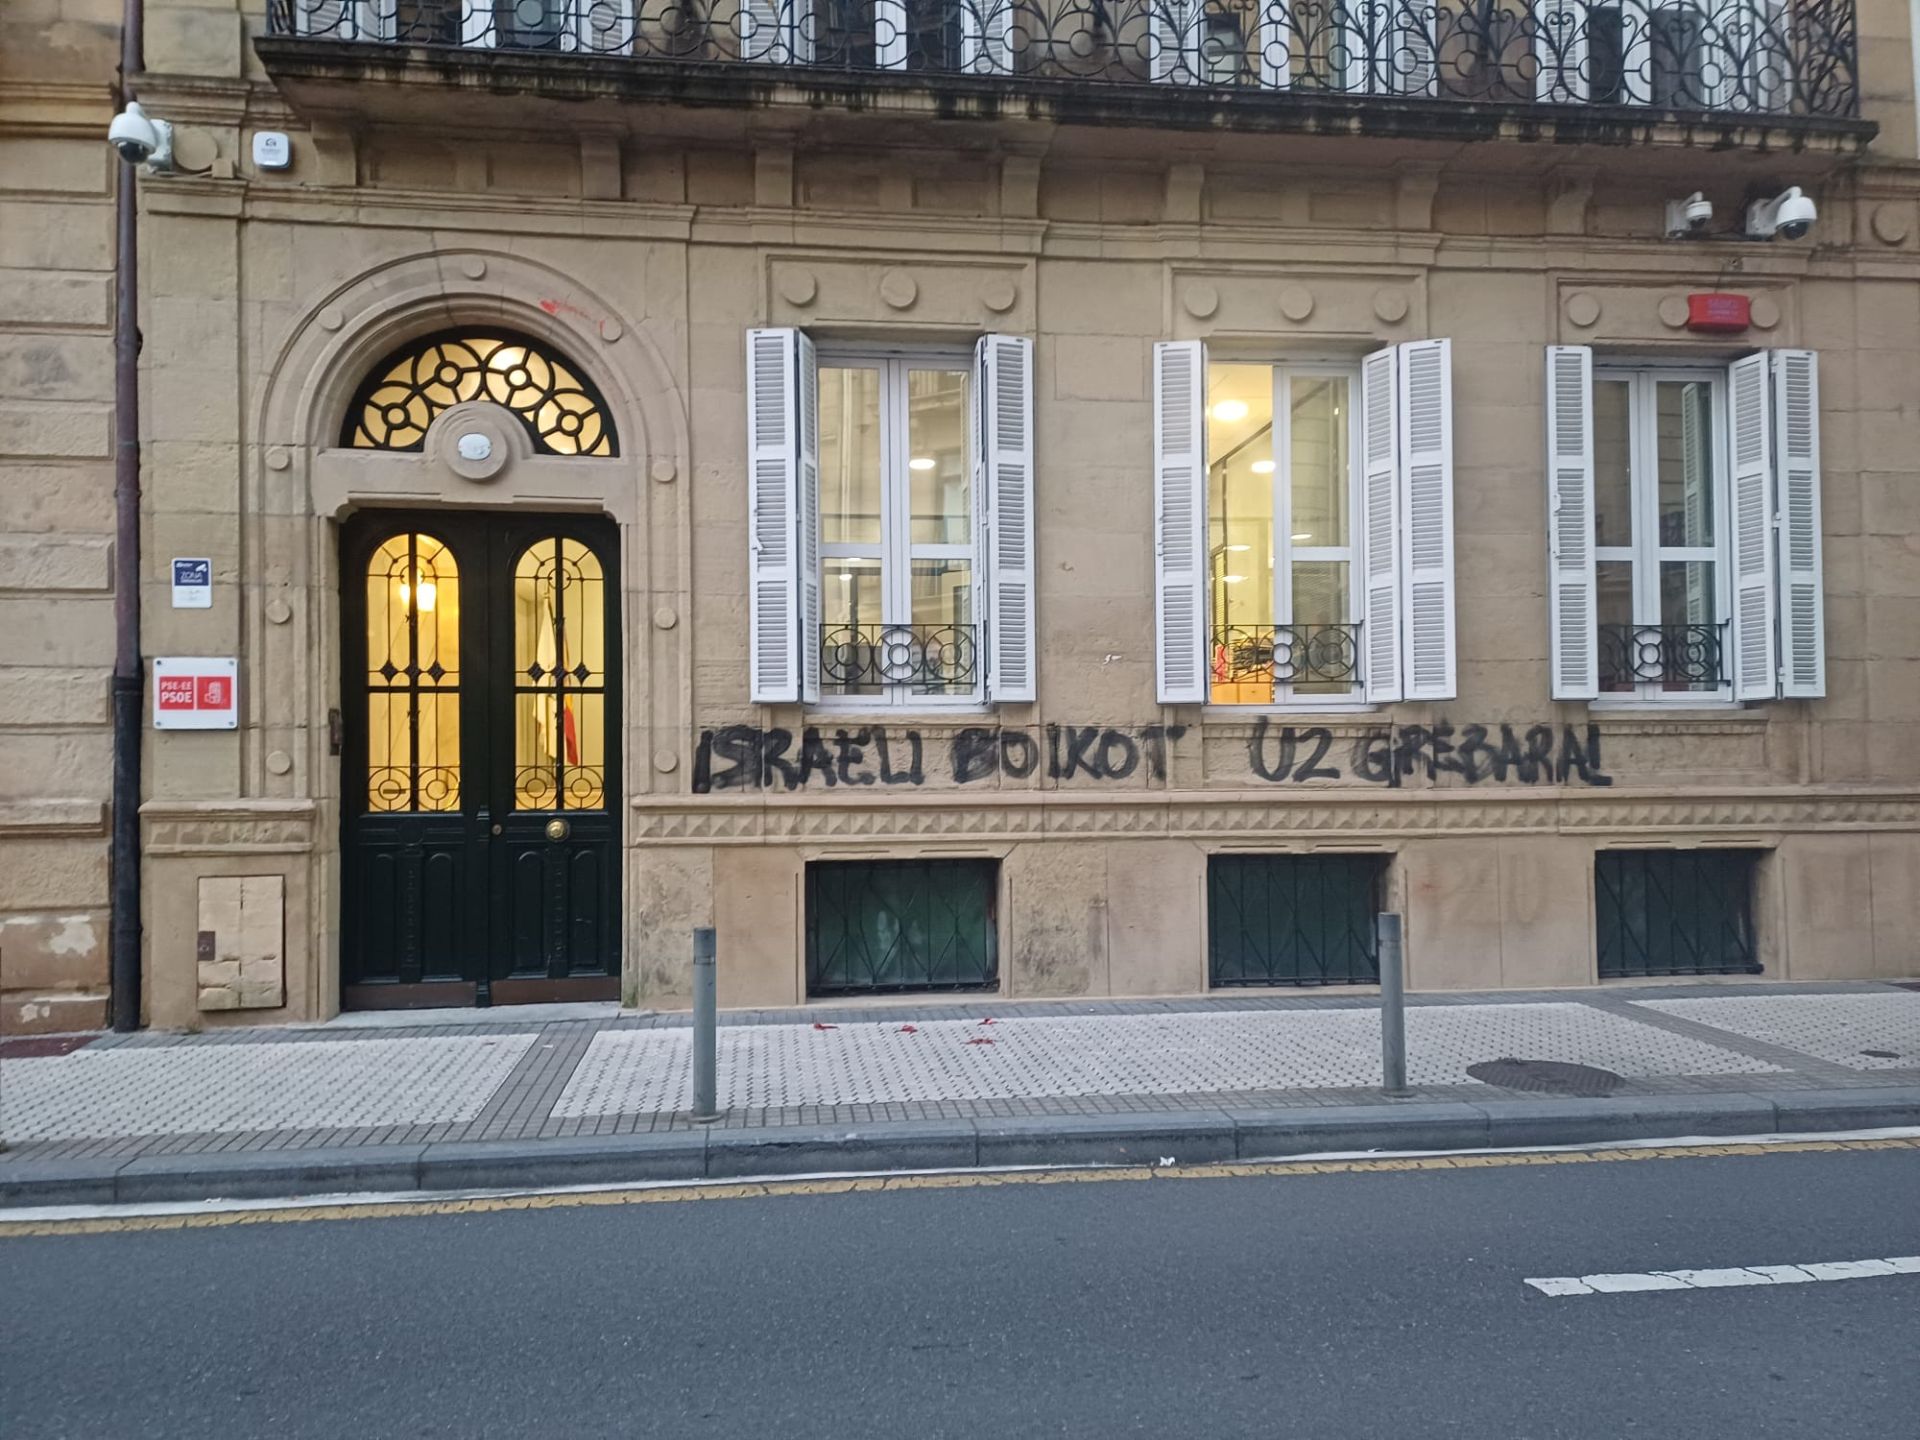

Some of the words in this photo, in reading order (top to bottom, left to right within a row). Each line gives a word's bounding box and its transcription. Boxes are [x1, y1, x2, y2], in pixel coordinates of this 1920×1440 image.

[161, 691, 193, 703] PSOE
[692, 724, 925, 793] ISRAELI
[951, 722, 1186, 784] BOIKOT
